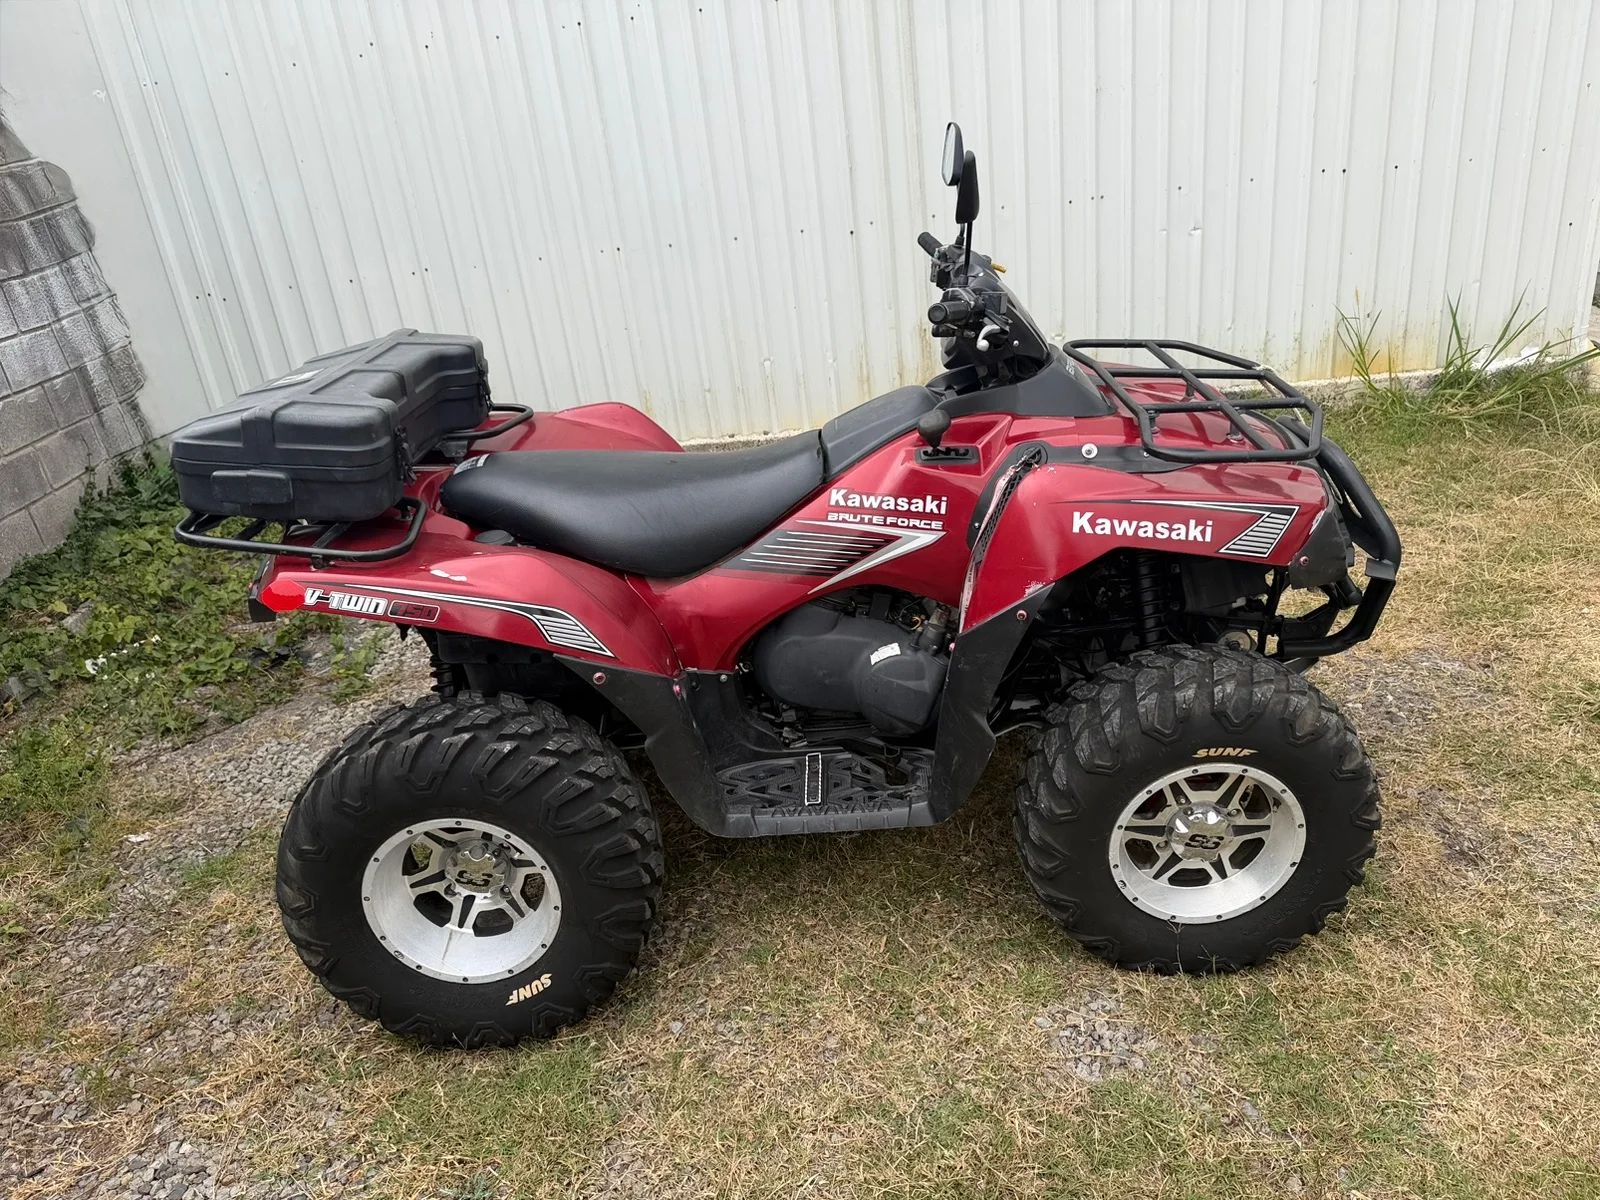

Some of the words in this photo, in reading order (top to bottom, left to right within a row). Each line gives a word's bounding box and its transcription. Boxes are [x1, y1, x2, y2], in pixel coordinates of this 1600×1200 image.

[829, 488, 948, 515] Kawasaki
[1072, 511, 1213, 543] Kawasaki
[1192, 747, 1259, 758] SUNF
[505, 973, 552, 1006] SUNF
